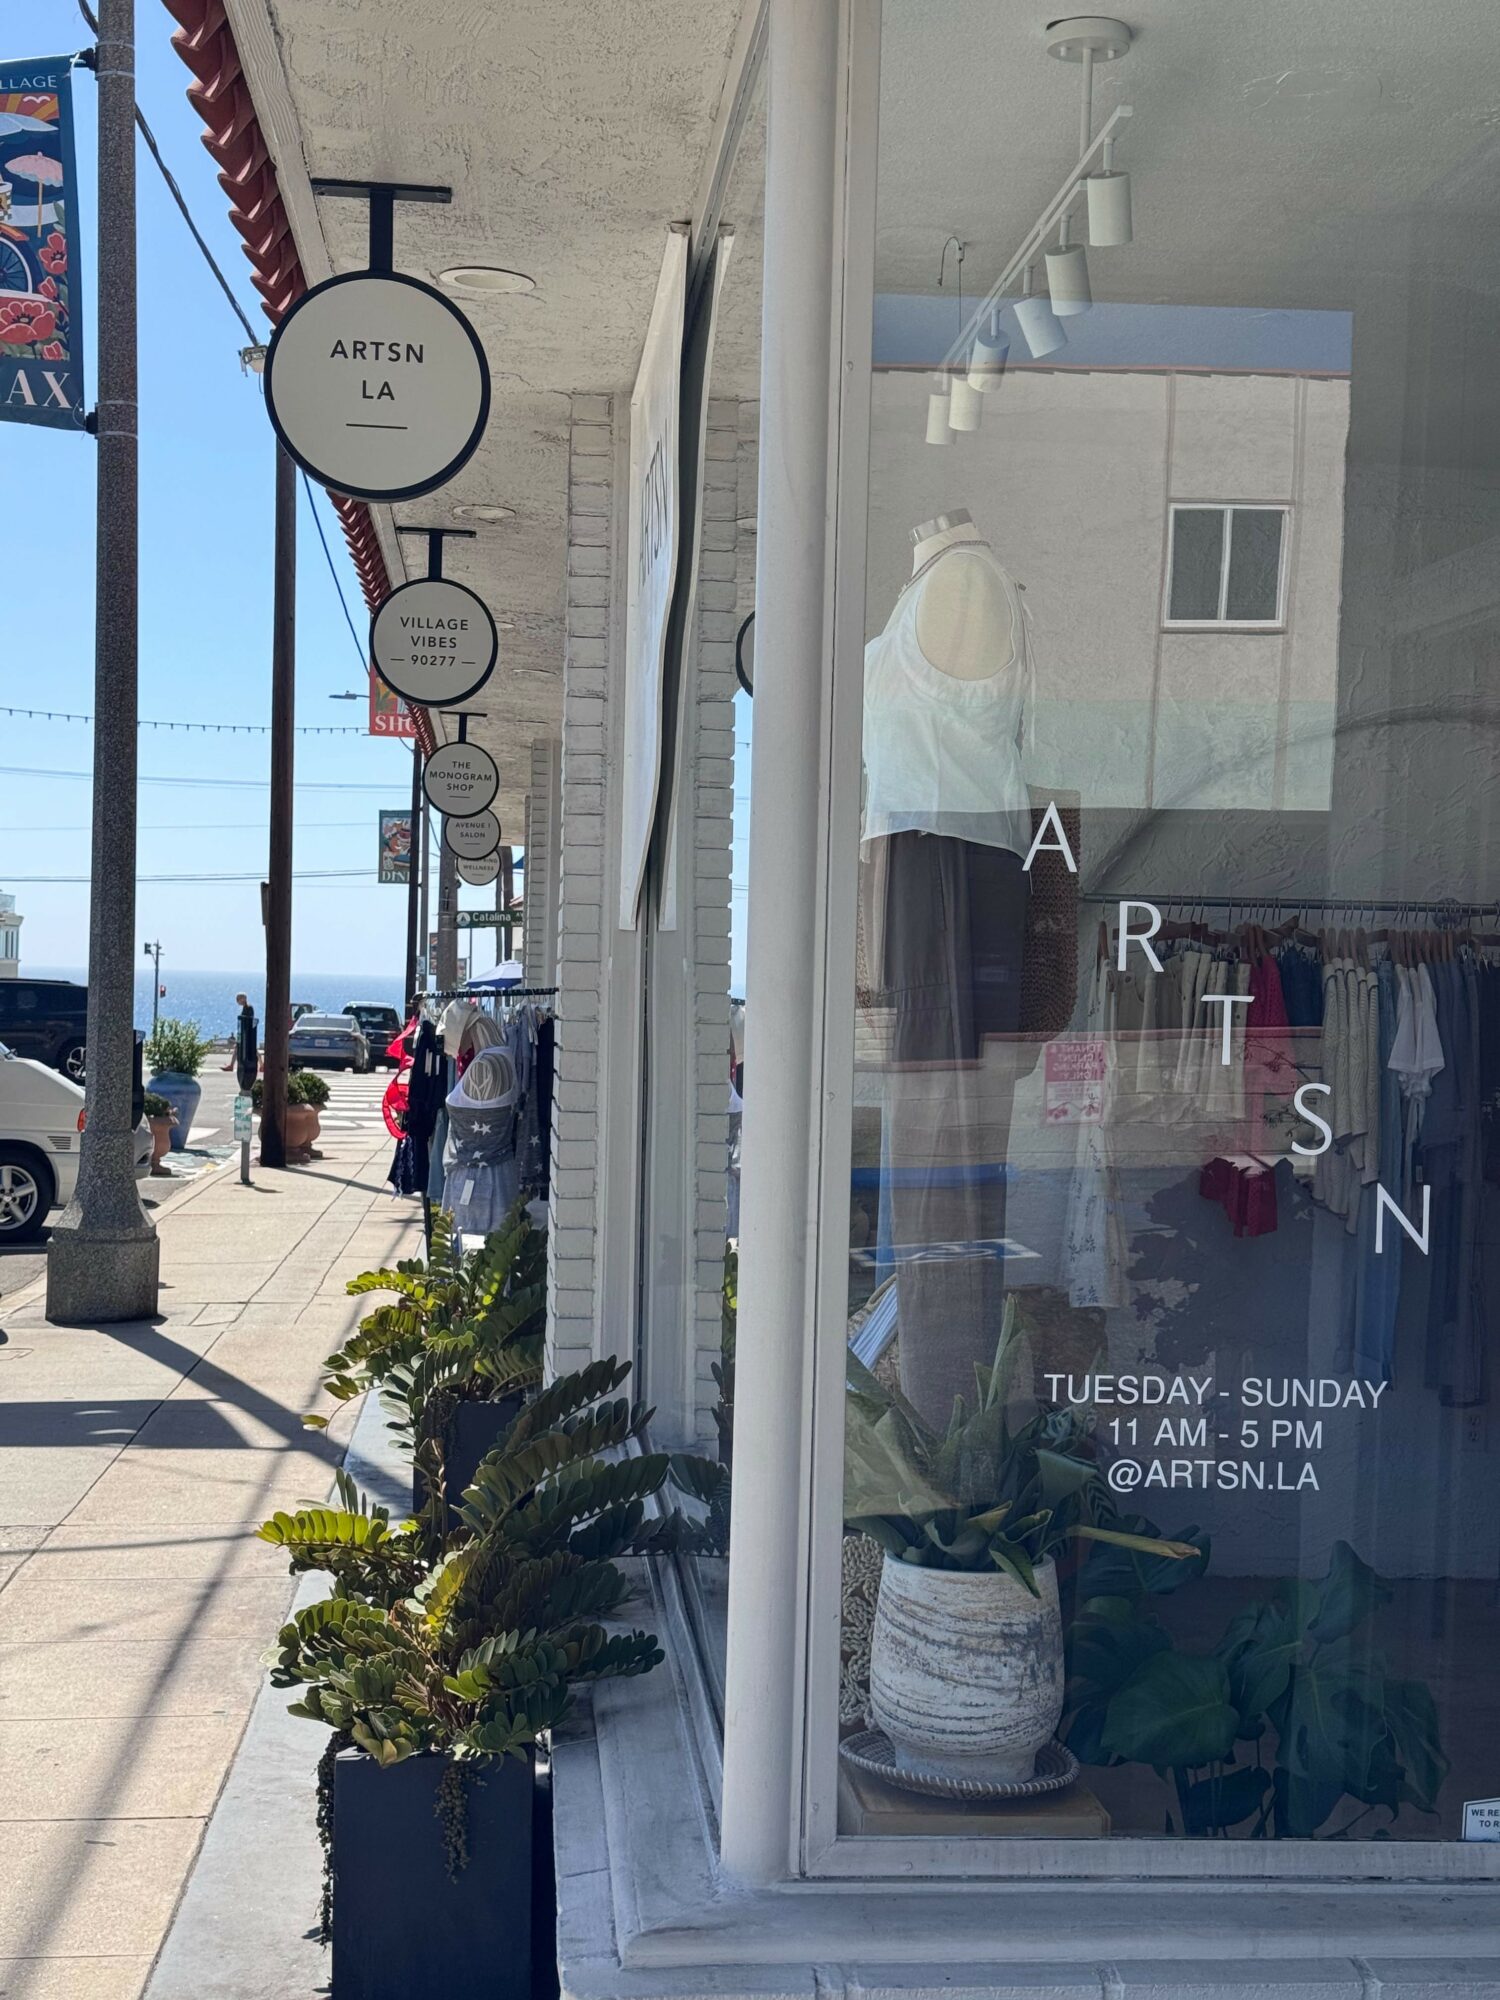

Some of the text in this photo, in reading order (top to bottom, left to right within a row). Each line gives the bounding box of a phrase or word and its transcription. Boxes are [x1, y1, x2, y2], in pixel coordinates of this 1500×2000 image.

[329, 339, 424, 363] ARTSN
[4, 369, 73, 409] AX
[362, 380, 395, 400] LA
[400, 616, 469, 631] VILLAGE
[410, 635, 457, 649] VIBES
[411, 654, 456, 667] 90277
[452, 761, 472, 770] THE
[429, 770, 492, 782] MONOGRAM
[446, 783, 474, 792] SHOP
[472, 912, 511, 922] Catalina
[1043, 1373, 1213, 1405] TUESDAY
[1241, 1377, 1389, 1409] SUNDAY
[1109, 1417, 1138, 1446] 11
[1154, 1417, 1207, 1447] AM
[1240, 1420, 1259, 1449] 5
[1271, 1420, 1323, 1449] PM
[1107, 1458, 1320, 1493] @ARTSN.LA
[1471, 1808, 1485, 1816] WE
[1480, 1820, 1491, 1828] TO
